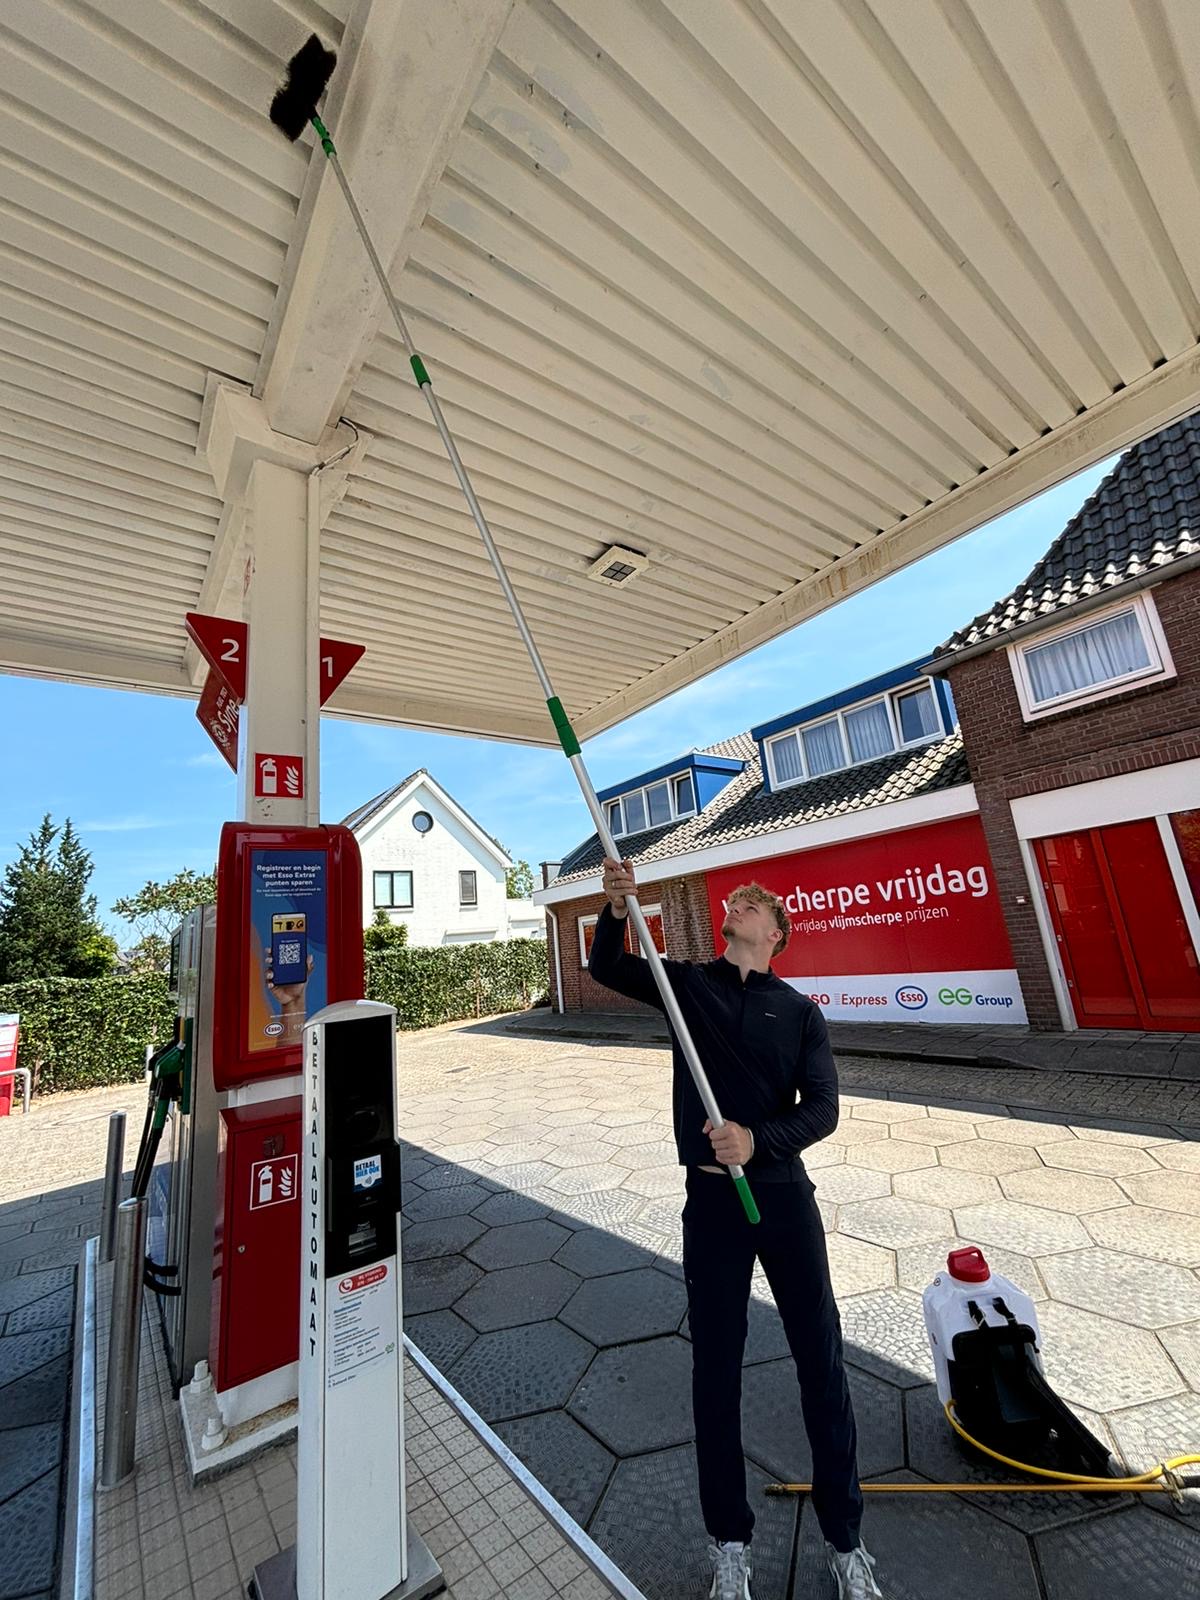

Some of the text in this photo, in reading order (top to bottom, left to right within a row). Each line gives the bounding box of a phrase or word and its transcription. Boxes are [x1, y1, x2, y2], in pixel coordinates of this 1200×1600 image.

[221, 638, 240, 663] 2
[321, 656, 333, 678] 1
[256, 864, 292, 873] Registreer
[303, 864, 321, 872] begin
[265, 880, 290, 888] punten
[876, 863, 989, 905] vrijdag
[794, 918, 828, 933] vrijdag
[828, 911, 903, 930] vlijmscherpe
[905, 906, 949, 923] prijzen
[841, 993, 888, 1008] Express
[900, 991, 924, 1002] Esso
[975, 994, 1013, 1008] Group
[310, 1031, 318, 1357] BETAALAUTOMAAT
